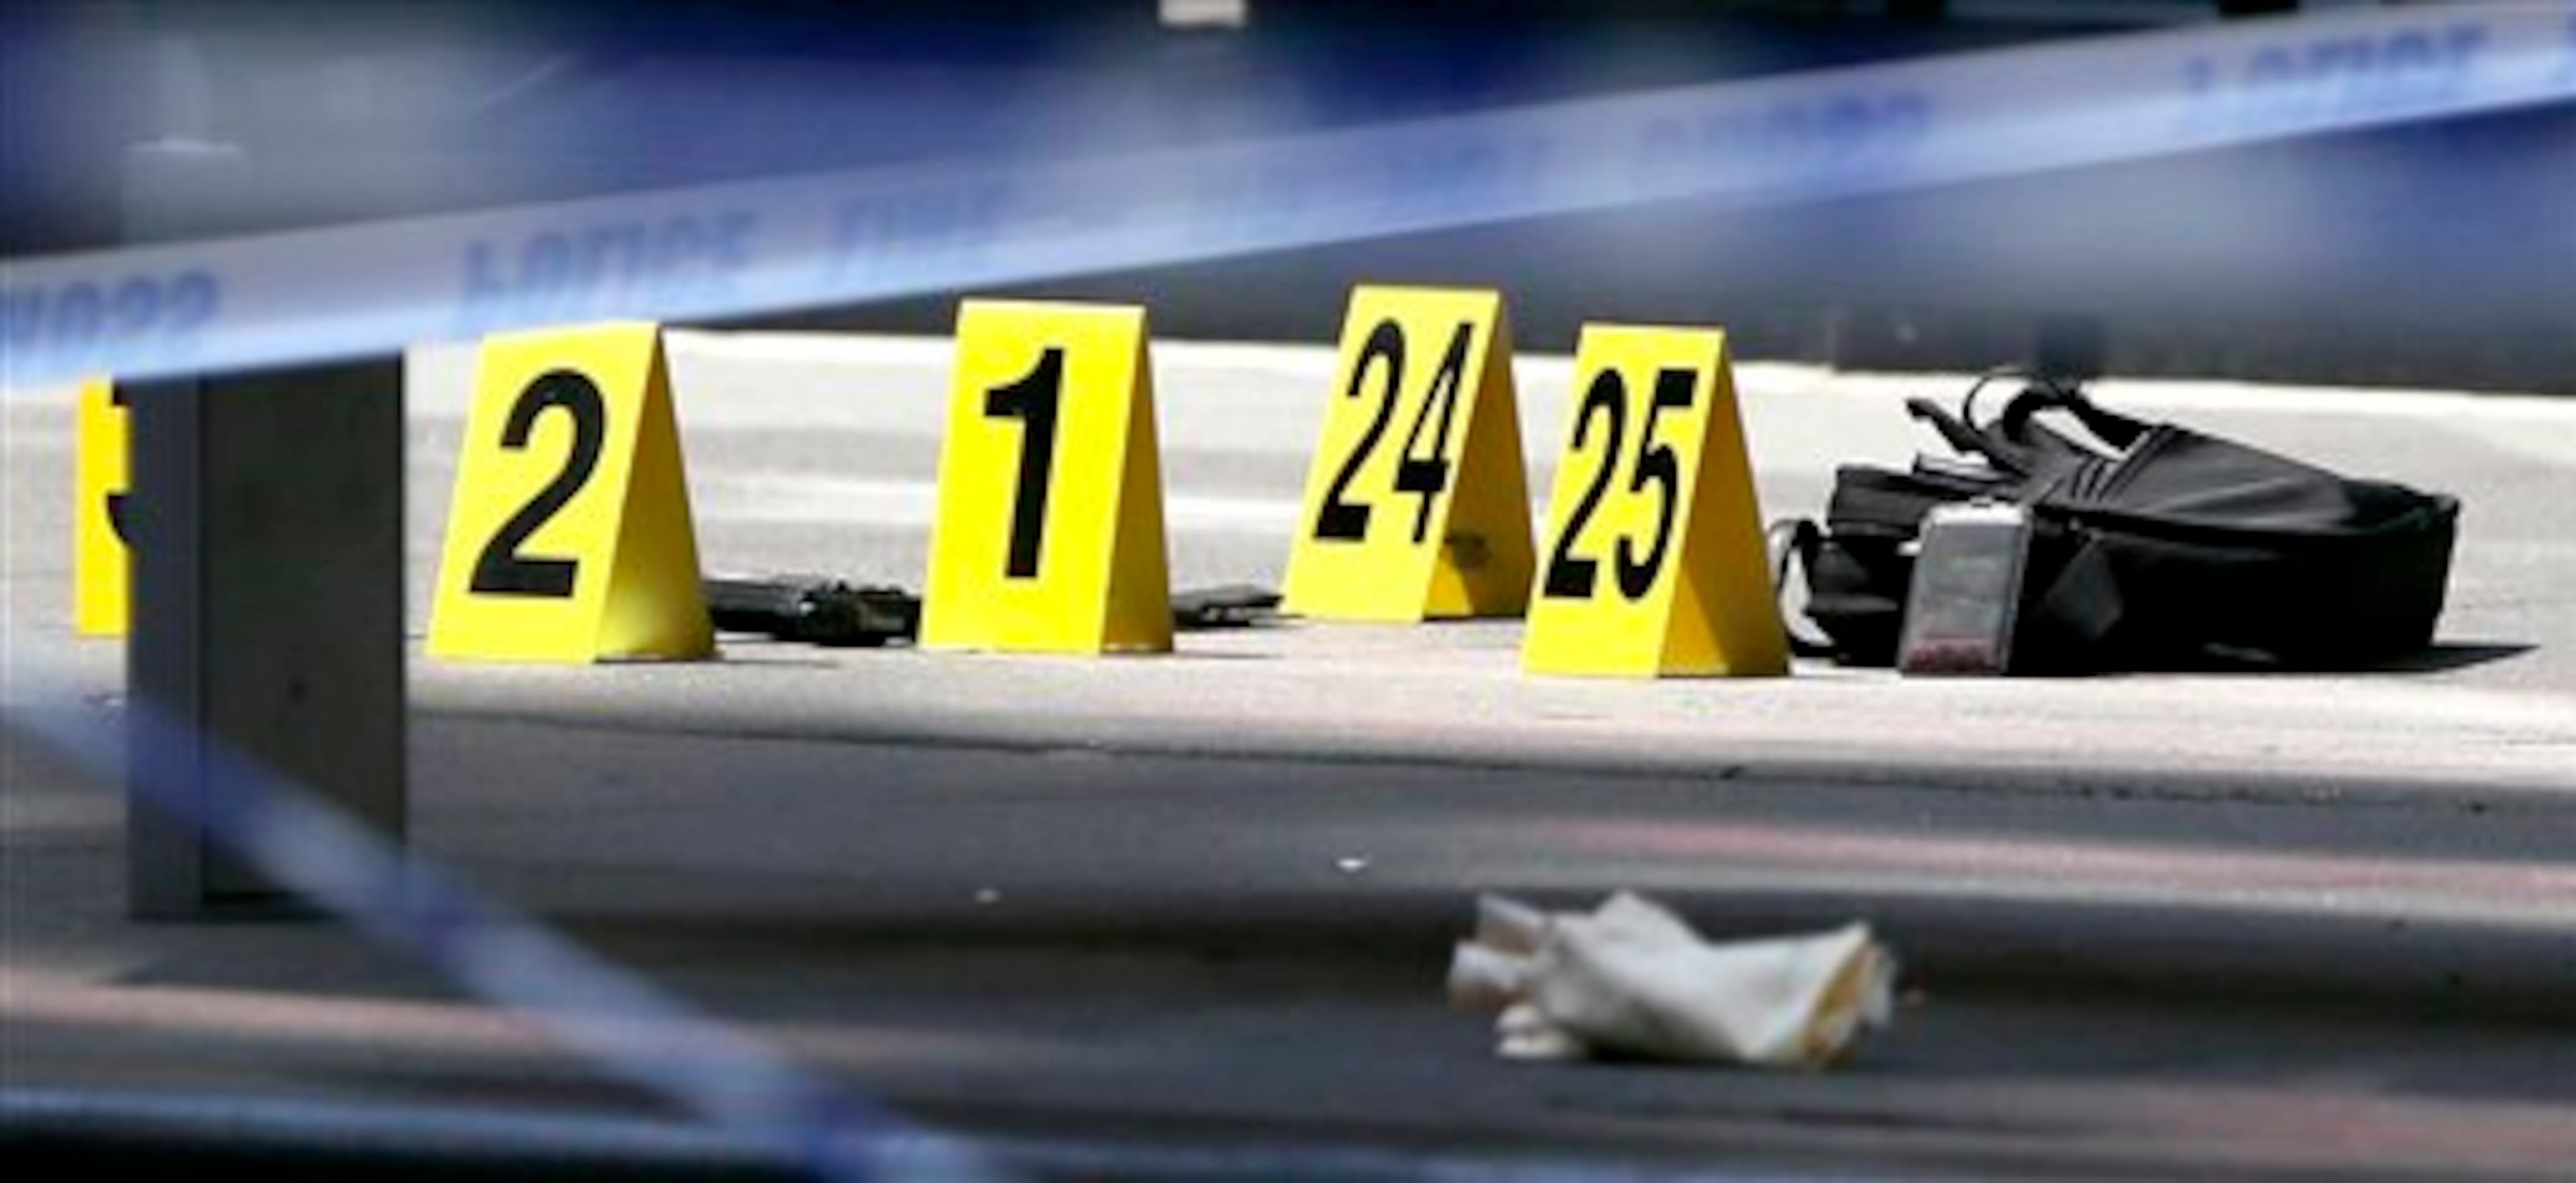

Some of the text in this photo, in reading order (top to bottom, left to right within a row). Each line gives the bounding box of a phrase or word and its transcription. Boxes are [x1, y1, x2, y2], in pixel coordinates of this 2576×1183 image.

[470, 369, 605, 597] 2
[984, 348, 1064, 578] 1
[1313, 319, 1473, 544] 24
[1544, 368, 1697, 599] 25
